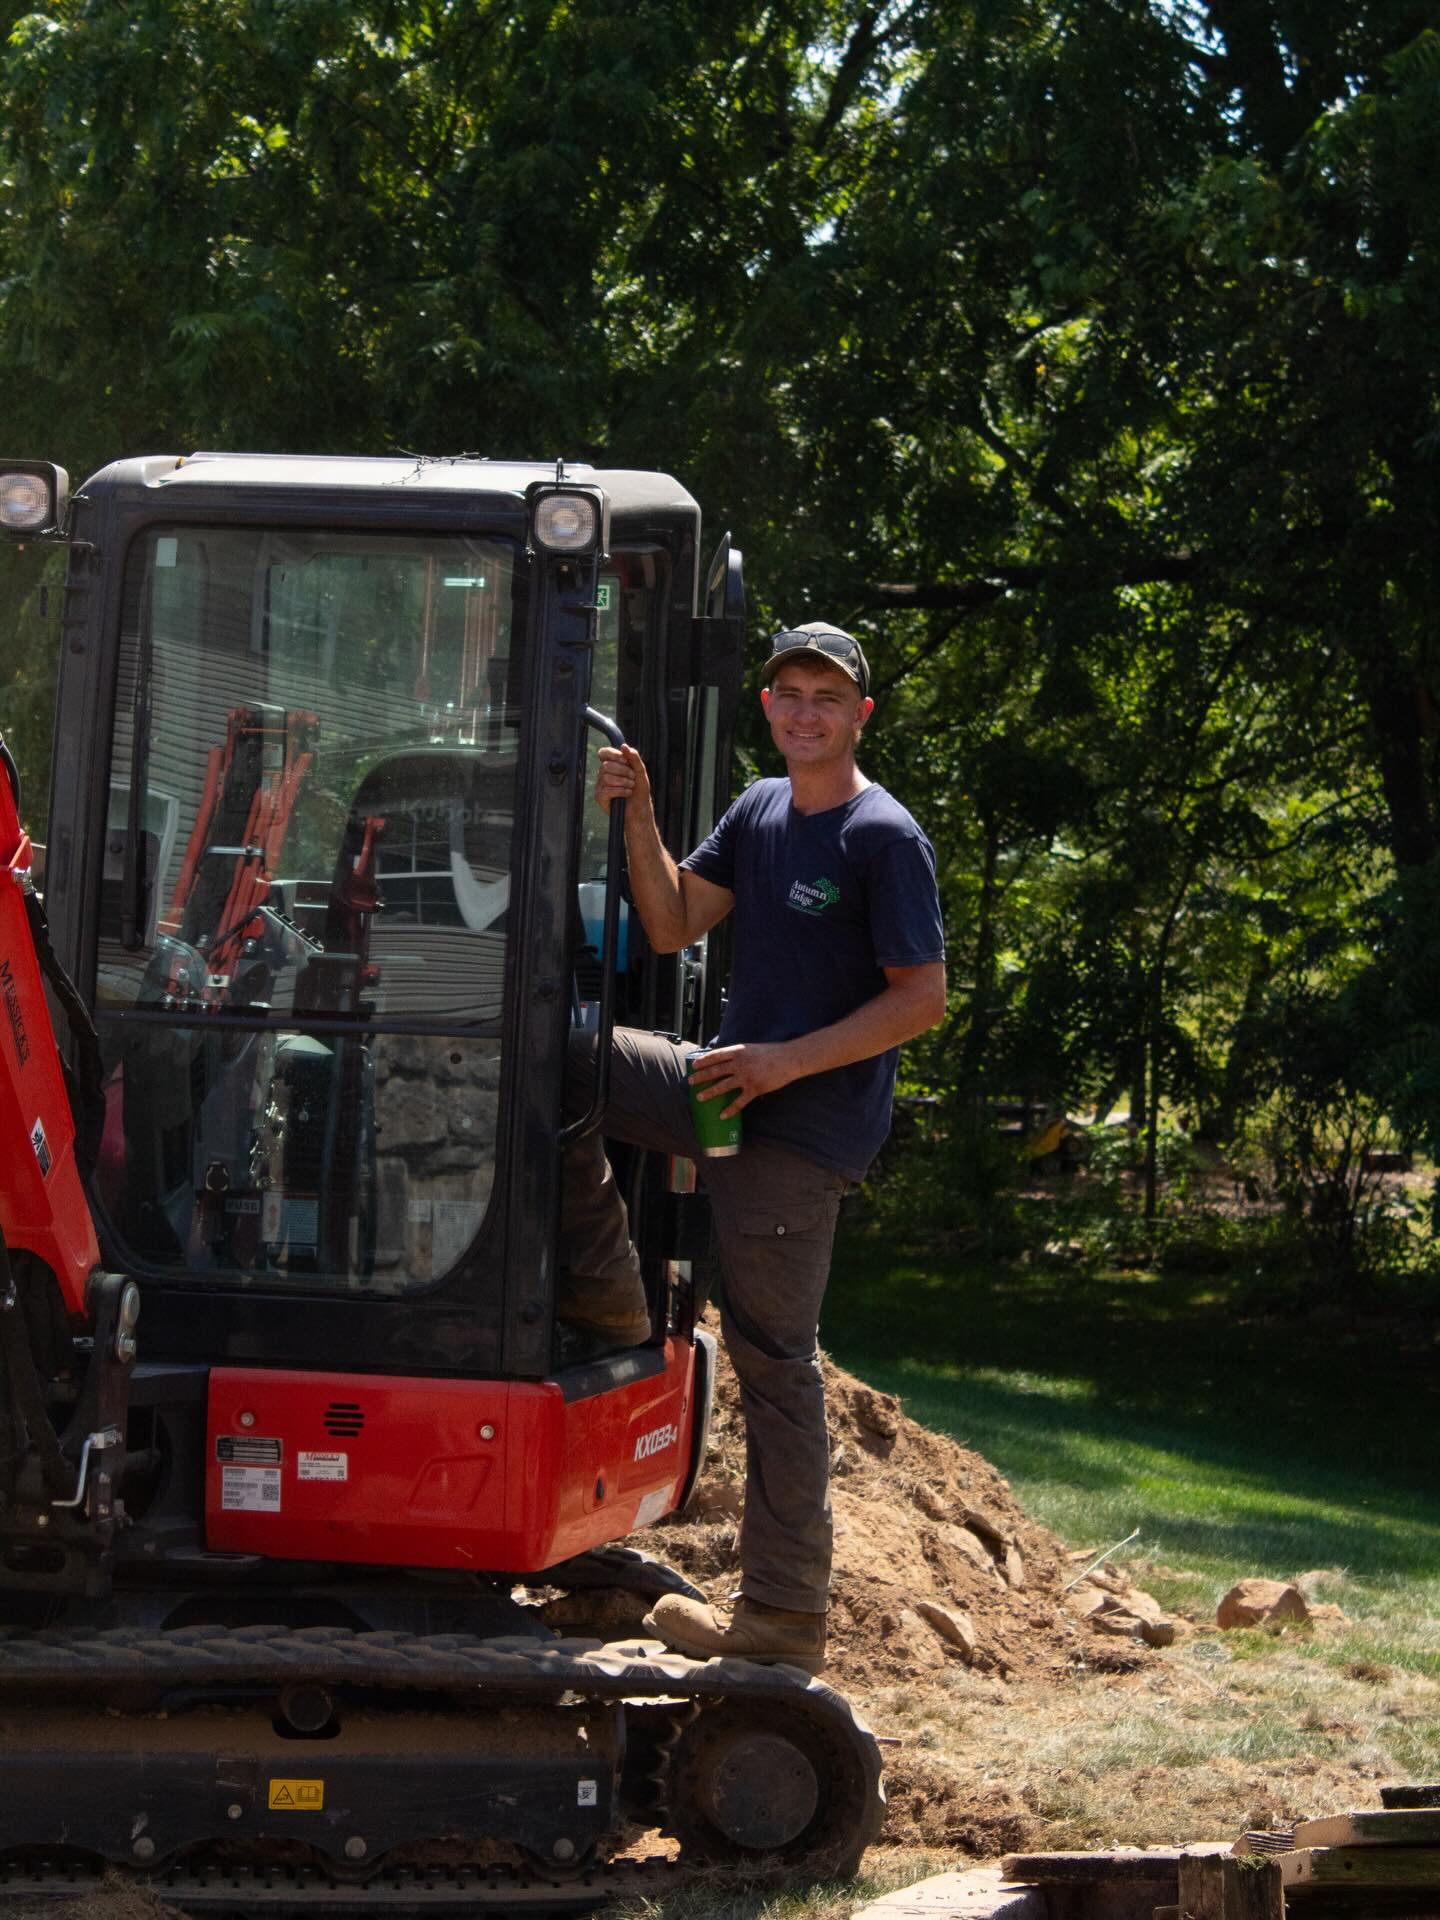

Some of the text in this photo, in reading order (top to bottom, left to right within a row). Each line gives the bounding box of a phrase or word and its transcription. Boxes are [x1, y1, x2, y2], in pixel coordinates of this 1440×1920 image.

[789, 888, 813, 906] Ridge
[792, 880, 827, 900] Autumn
[634, 1424, 678, 1462] KX033-4
